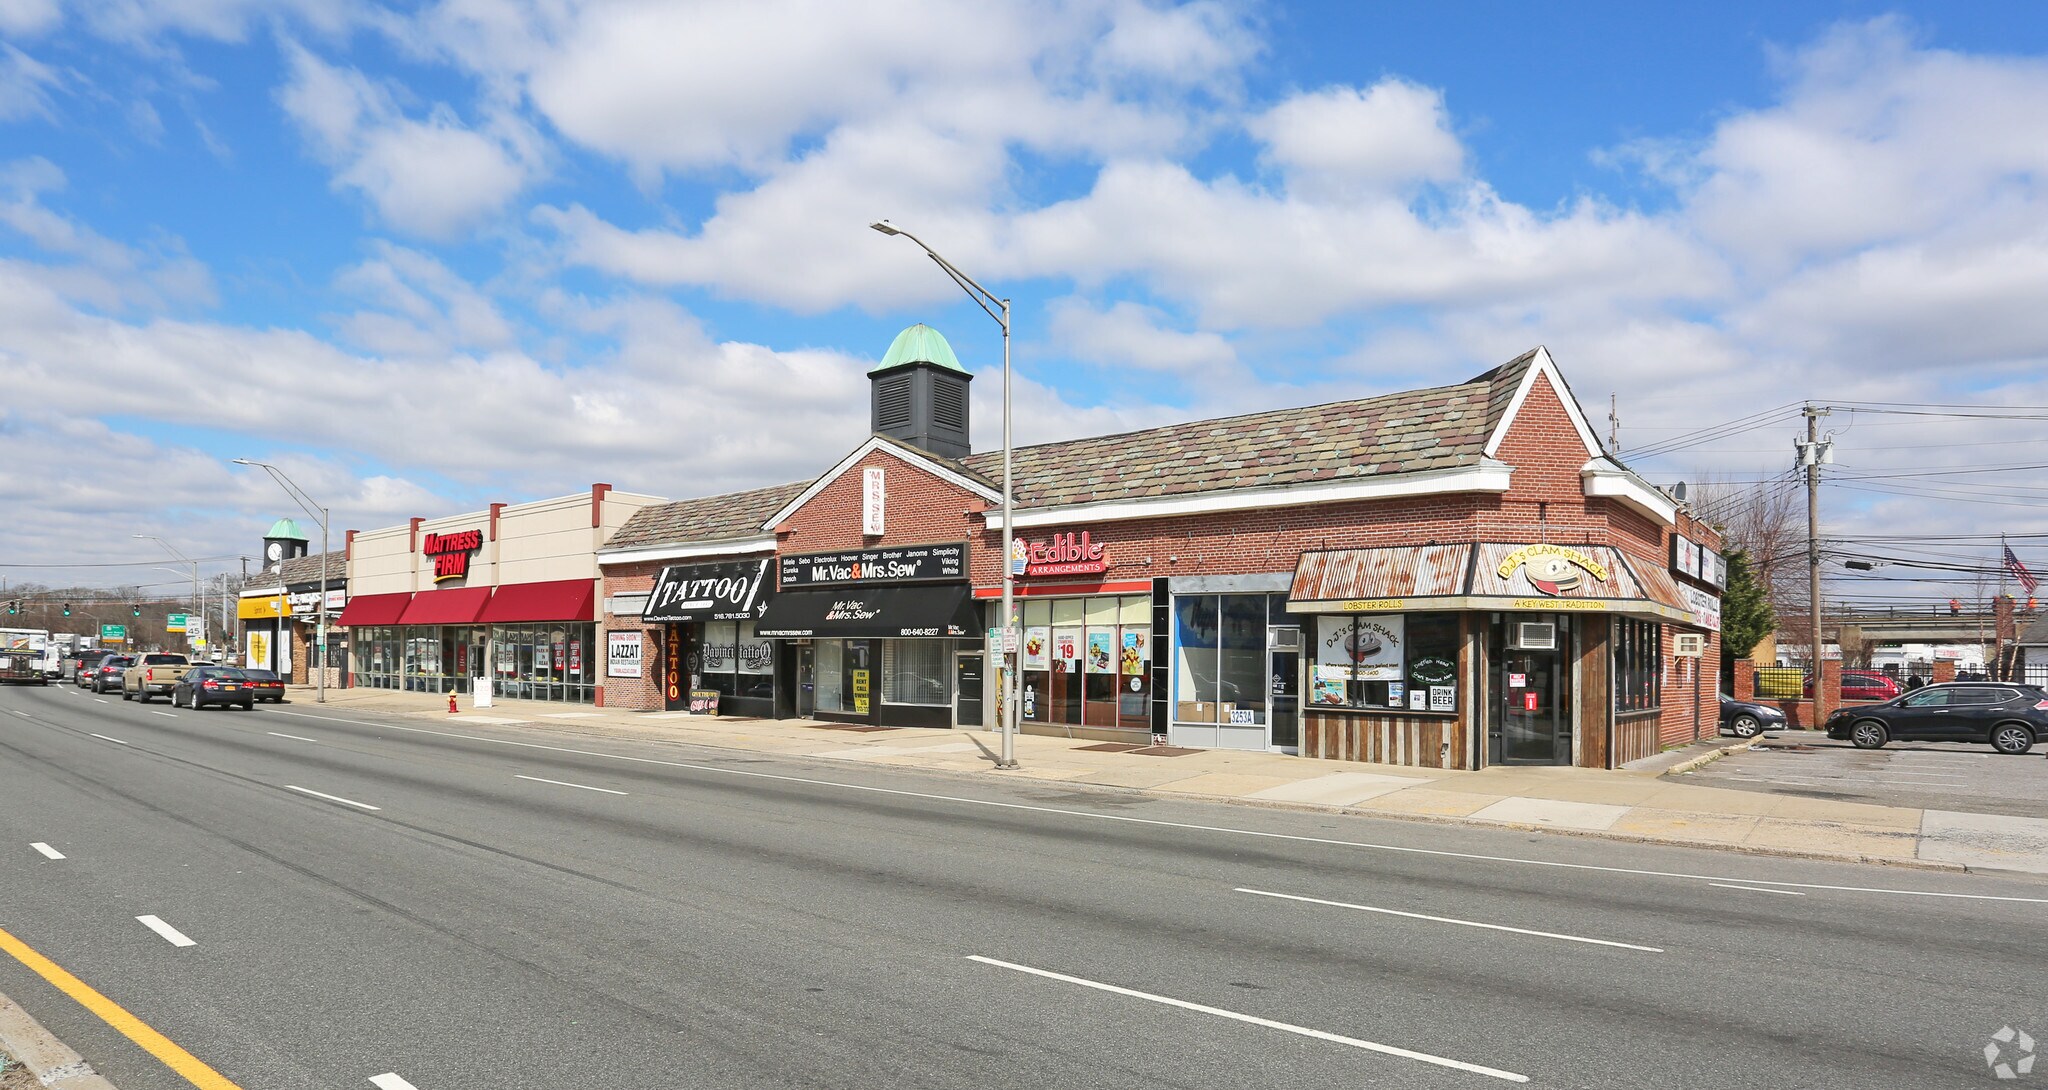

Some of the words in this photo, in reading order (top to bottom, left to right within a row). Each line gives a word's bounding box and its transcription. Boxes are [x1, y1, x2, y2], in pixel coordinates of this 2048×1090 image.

[424, 530, 480, 554] MATTRESS
[1030, 531, 1102, 564] Edible
[783, 558, 795, 566] Miele
[798, 557, 811, 565] Sebo
[814, 555, 837, 564] Electrolux
[840, 554, 858, 562] Hoover
[862, 552, 879, 561] Singer
[882, 551, 902, 559] Brother
[906, 549, 928, 558] Janome
[932, 547, 960, 557] Simplicity
[941, 557, 959, 566] Viking
[434, 552, 467, 576] FIRM
[1526, 546, 1561, 557] CLAM
[1563, 549, 1607, 579] SHACK
[783, 566, 799, 574] Eureka
[941, 567, 959, 575] White
[1031, 564, 1101, 574] ARRANGEMENTS
[782, 575, 797, 583] Bosch
[659, 577, 748, 608] TATTOO
[1343, 601, 1377, 610] LOBSTER
[1378, 600, 1403, 609] ROLLS
[1522, 600, 1537, 608] KEY
[1561, 601, 1605, 609] TRADITION
[188, 627, 200, 635] 45
[900, 628, 939, 636] 800-640-8227
[1347, 622, 1372, 631] CAM
[1372, 623, 1400, 648] SHACK
[610, 633, 626, 642] COMING
[611, 644, 639, 659] LAZZAT
[702, 642, 735, 660] Davinci
[1432, 688, 1453, 696] DRINK
[1432, 696, 1453, 705] BEER
[1231, 711, 1253, 724] 3253A
